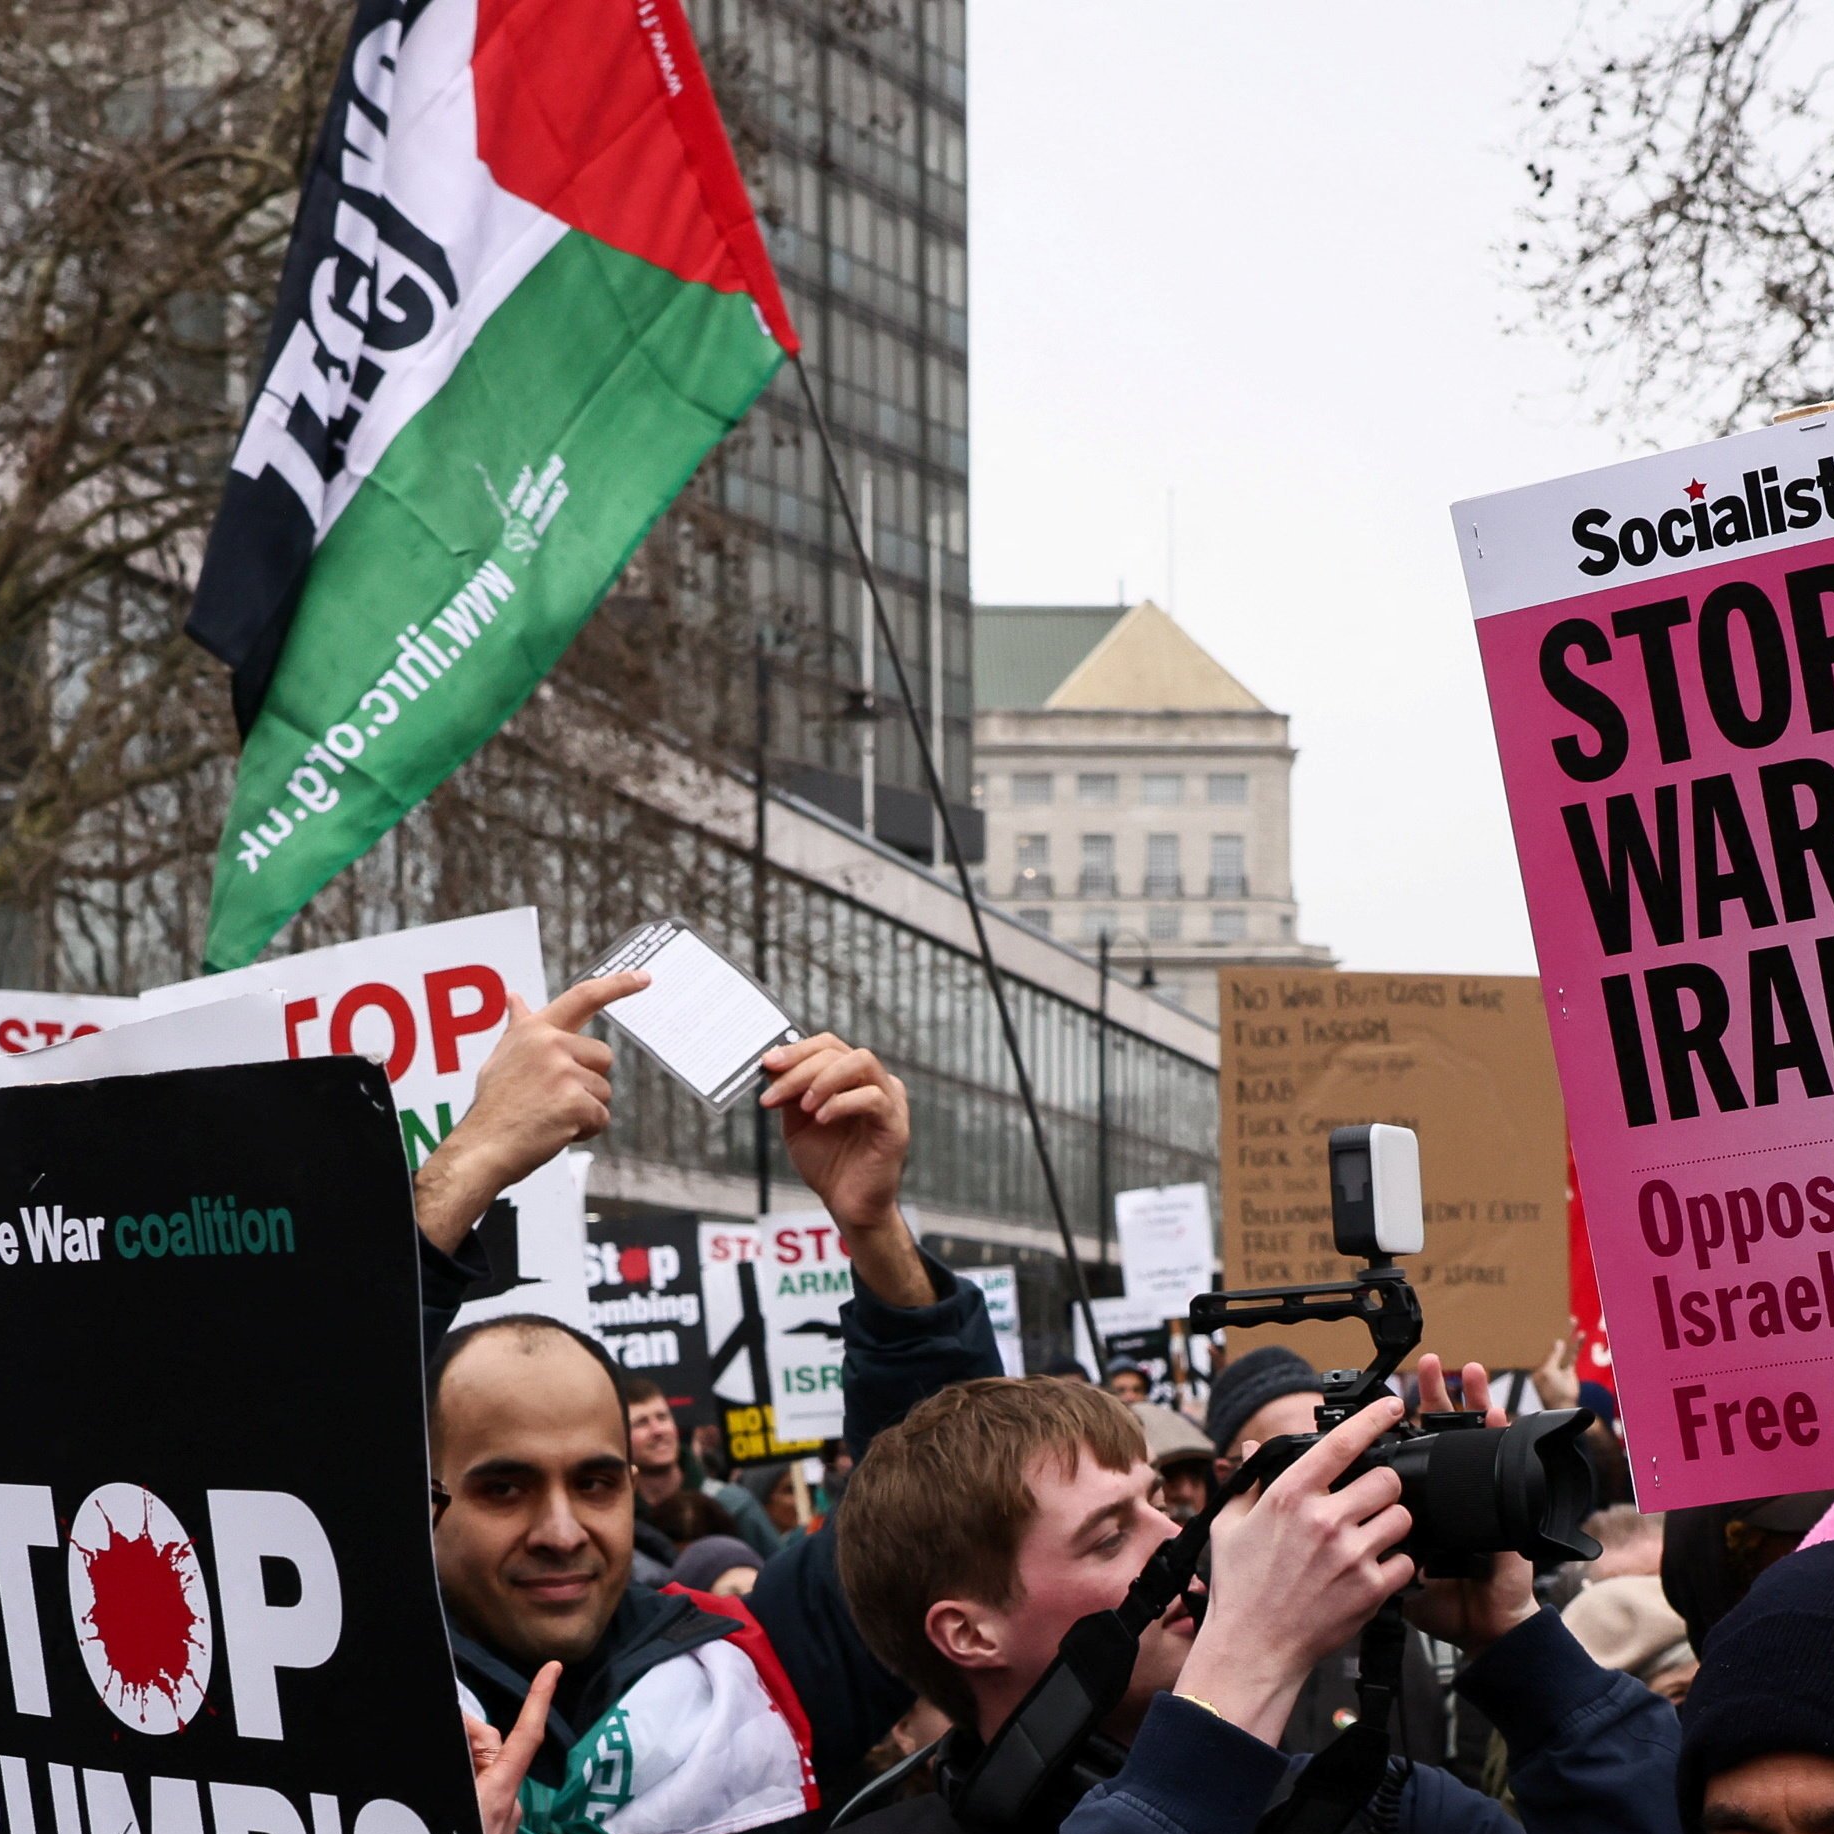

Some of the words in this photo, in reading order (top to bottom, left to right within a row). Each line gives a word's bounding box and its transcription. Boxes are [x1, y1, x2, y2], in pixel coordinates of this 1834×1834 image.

[20, 1204, 105, 1263] War
[115, 1195, 295, 1259] coalition
[1671, 1383, 1820, 1462] Free
